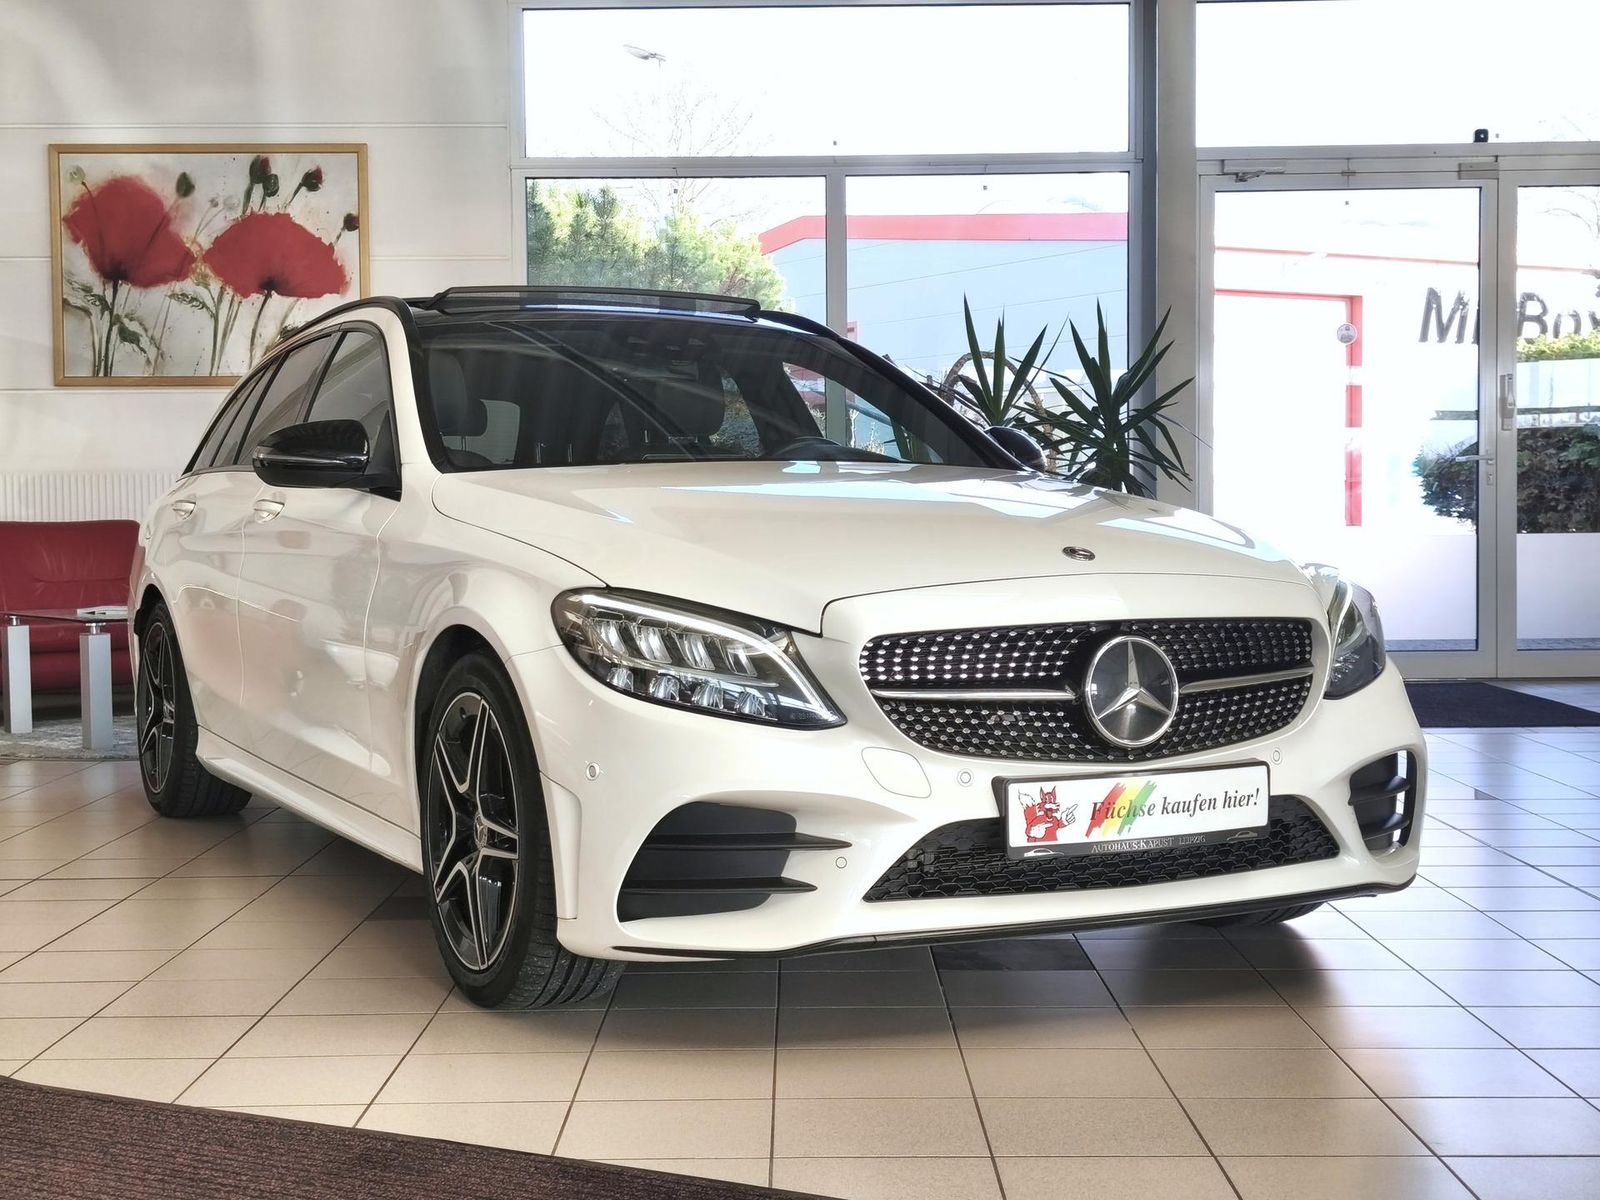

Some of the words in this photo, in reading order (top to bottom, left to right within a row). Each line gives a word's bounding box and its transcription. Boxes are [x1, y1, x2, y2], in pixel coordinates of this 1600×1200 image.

[1089, 801, 1156, 821] Füchse
[1161, 793, 1217, 817] kaufen
[1222, 788, 1260, 808] hier!
